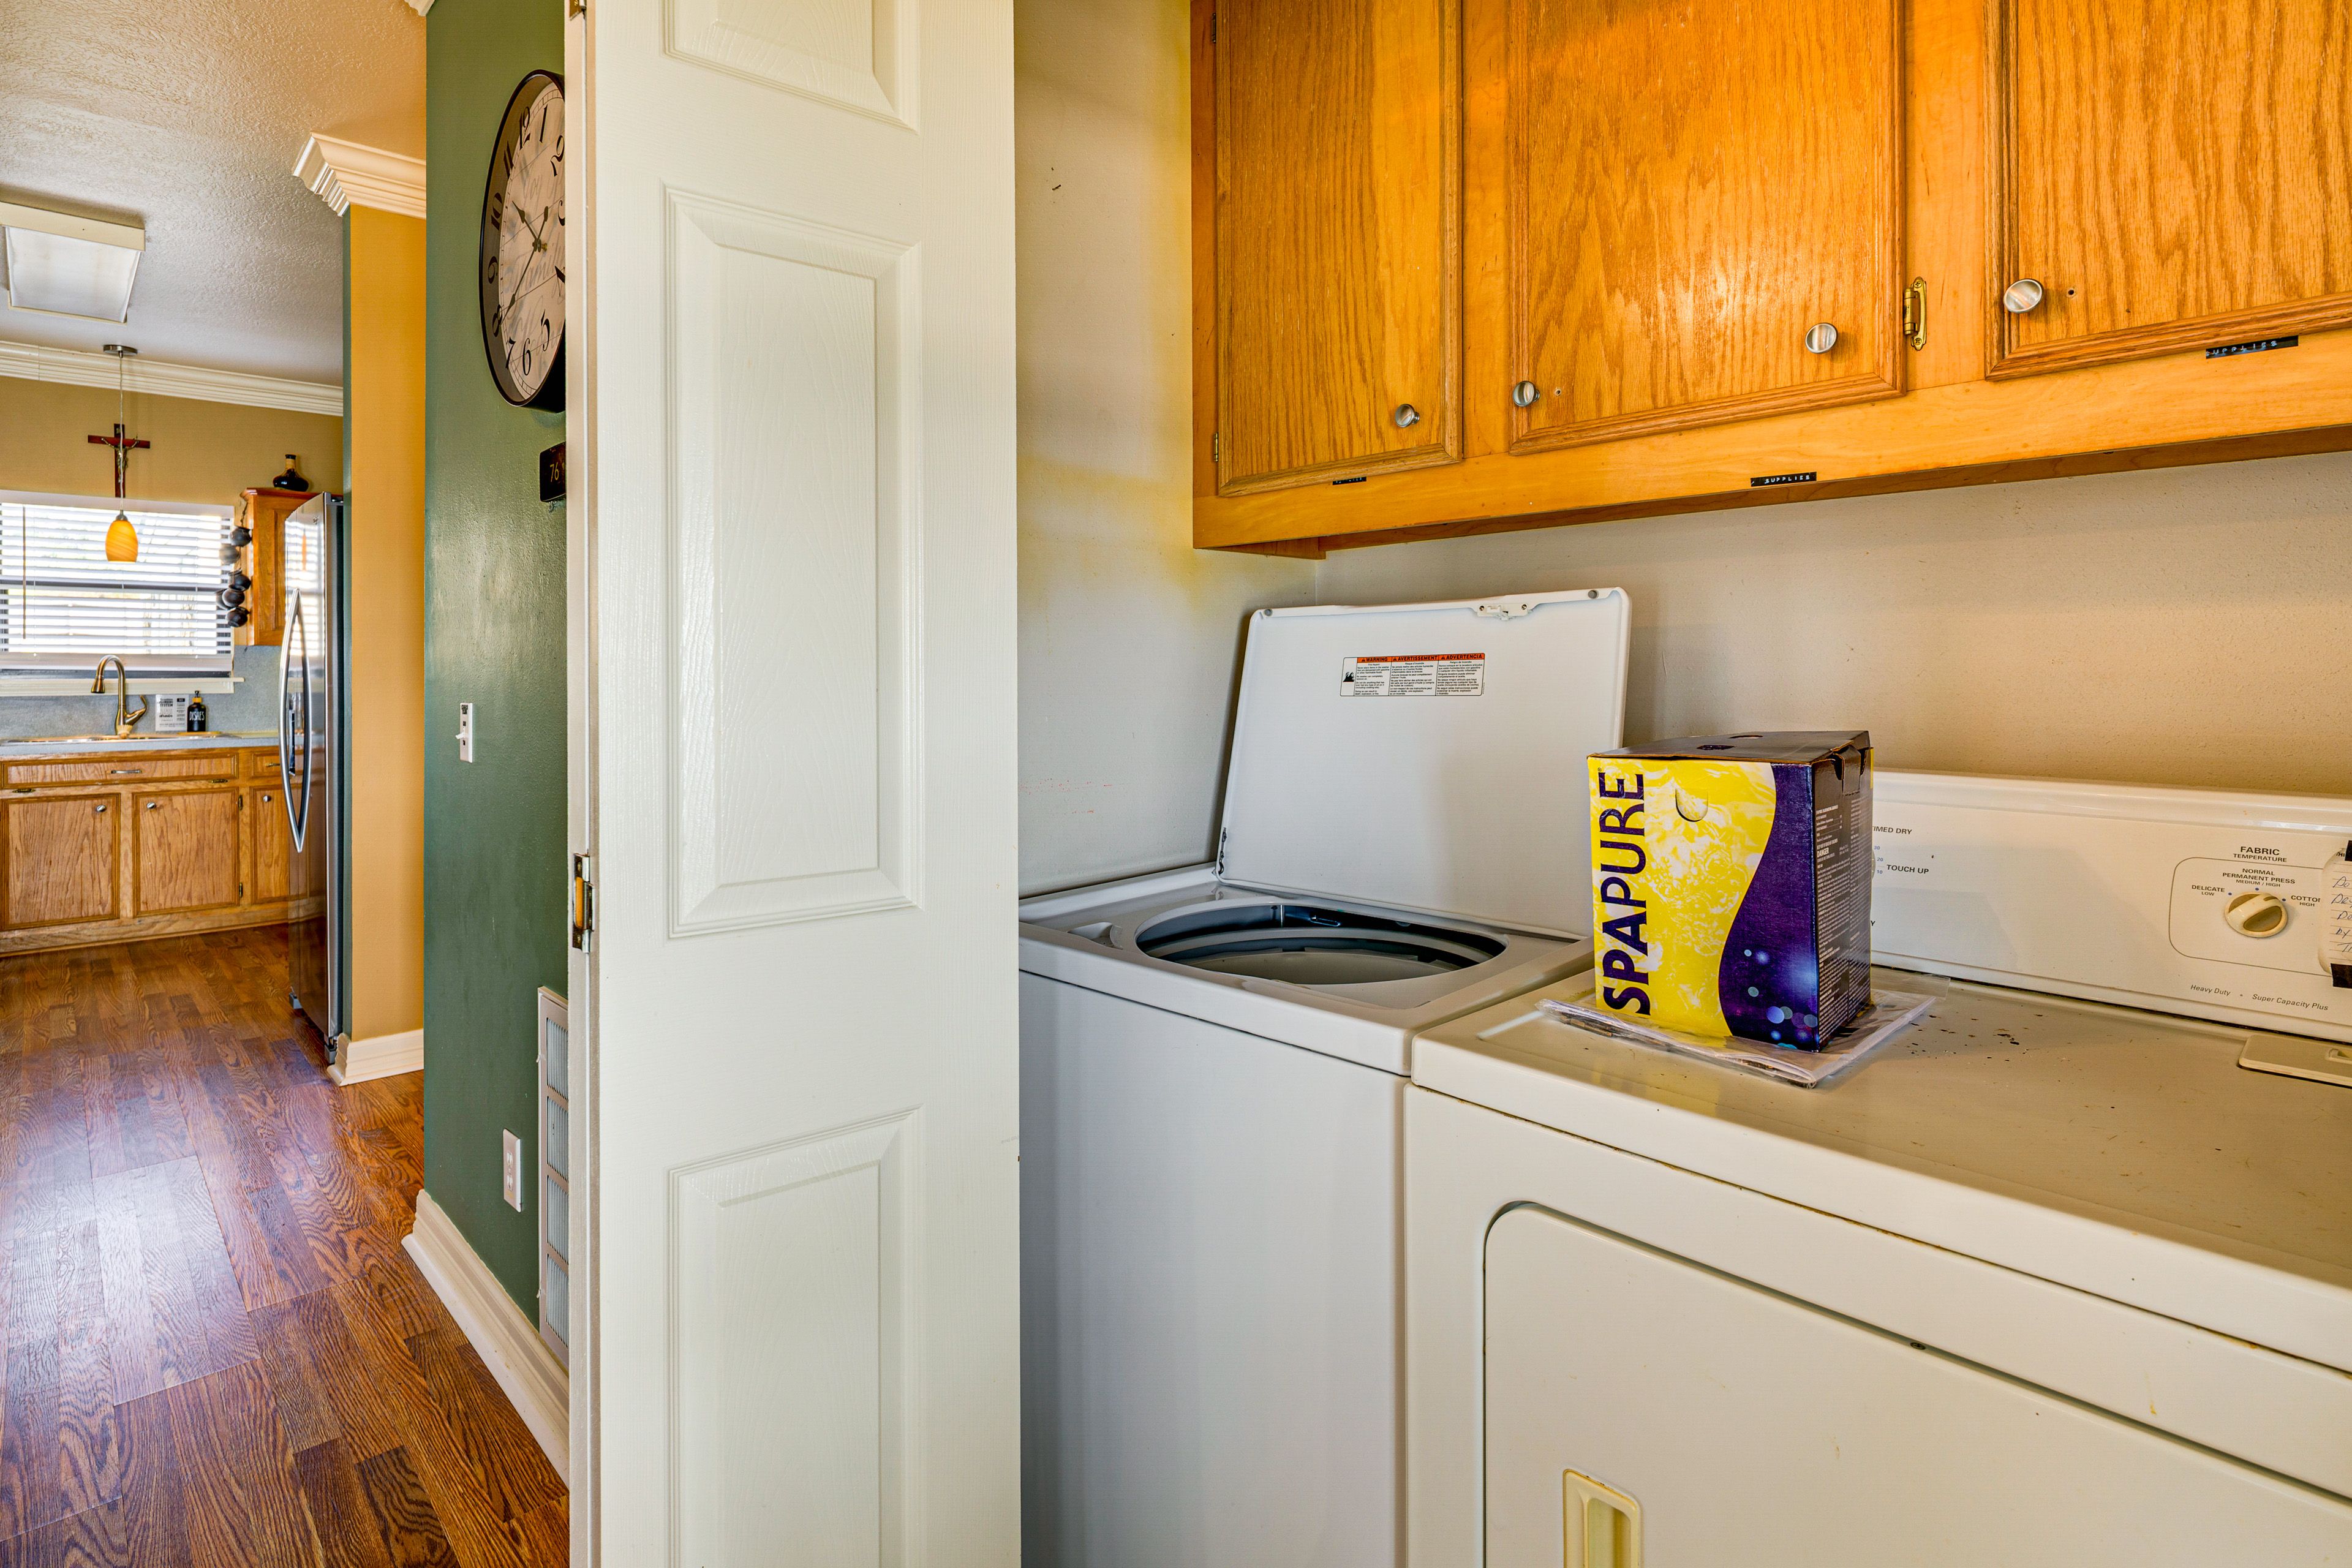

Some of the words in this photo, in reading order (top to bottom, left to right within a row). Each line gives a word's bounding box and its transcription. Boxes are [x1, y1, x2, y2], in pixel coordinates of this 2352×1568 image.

[519, 106, 531, 151] 12
[538, 104, 548, 143] 1
[491, 192, 503, 231] 10
[488, 255, 499, 284] 9
[492, 304, 503, 337] 8
[540, 308, 551, 352] 5
[505, 336, 516, 370] 7
[522, 337, 532, 376] 6
[2206, 341, 2277, 356] SUPPLIES
[549, 461, 559, 483] 76
[1764, 475, 1810, 484] SUPPLIES
[189, 710, 205, 721] DISHES
[1817, 847, 1830, 858] DANGER
[2233, 853, 2287, 862] TEMPERATURE
[2240, 846, 2280, 856] FABRIC
[1887, 864, 1915, 873] TOUCH
[2222, 872, 2269, 882] PERMANENT
[1598, 772, 1651, 1016] SPAPURE
[2190, 984, 2213, 993] Heavy
[2214, 988, 2231, 997] Duty
[2252, 993, 2274, 1003] Super
[2277, 997, 2310, 1009] Capacity
[2312, 1002, 2329, 1011] Plus
